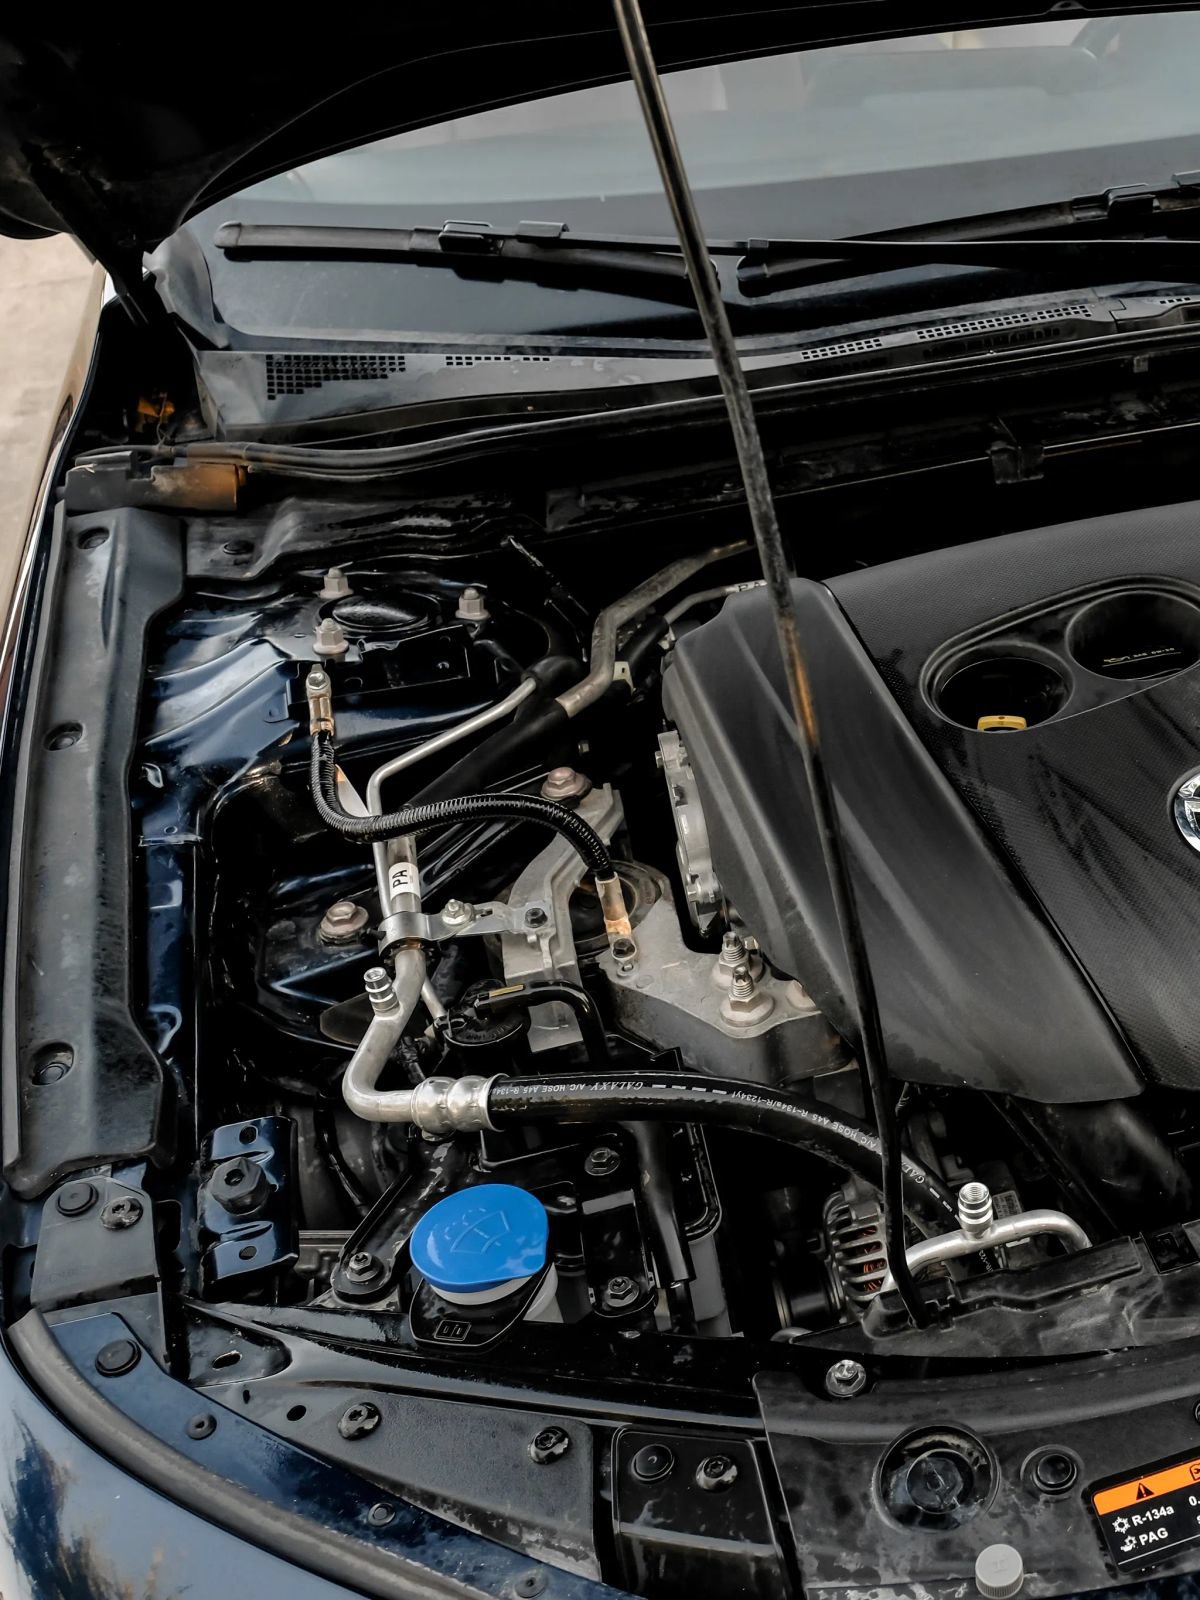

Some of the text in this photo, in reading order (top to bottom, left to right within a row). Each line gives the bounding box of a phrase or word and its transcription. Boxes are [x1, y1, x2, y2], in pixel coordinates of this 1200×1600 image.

[392, 869, 408, 888] PA
[542, 1084, 566, 1092] HOSE
[569, 1083, 586, 1091] A/C
[590, 1081, 644, 1091] GALAXY
[832, 1121, 857, 1140] HOSE
[1131, 1505, 1175, 1528] R-134a
[1138, 1527, 1169, 1546] PAG
